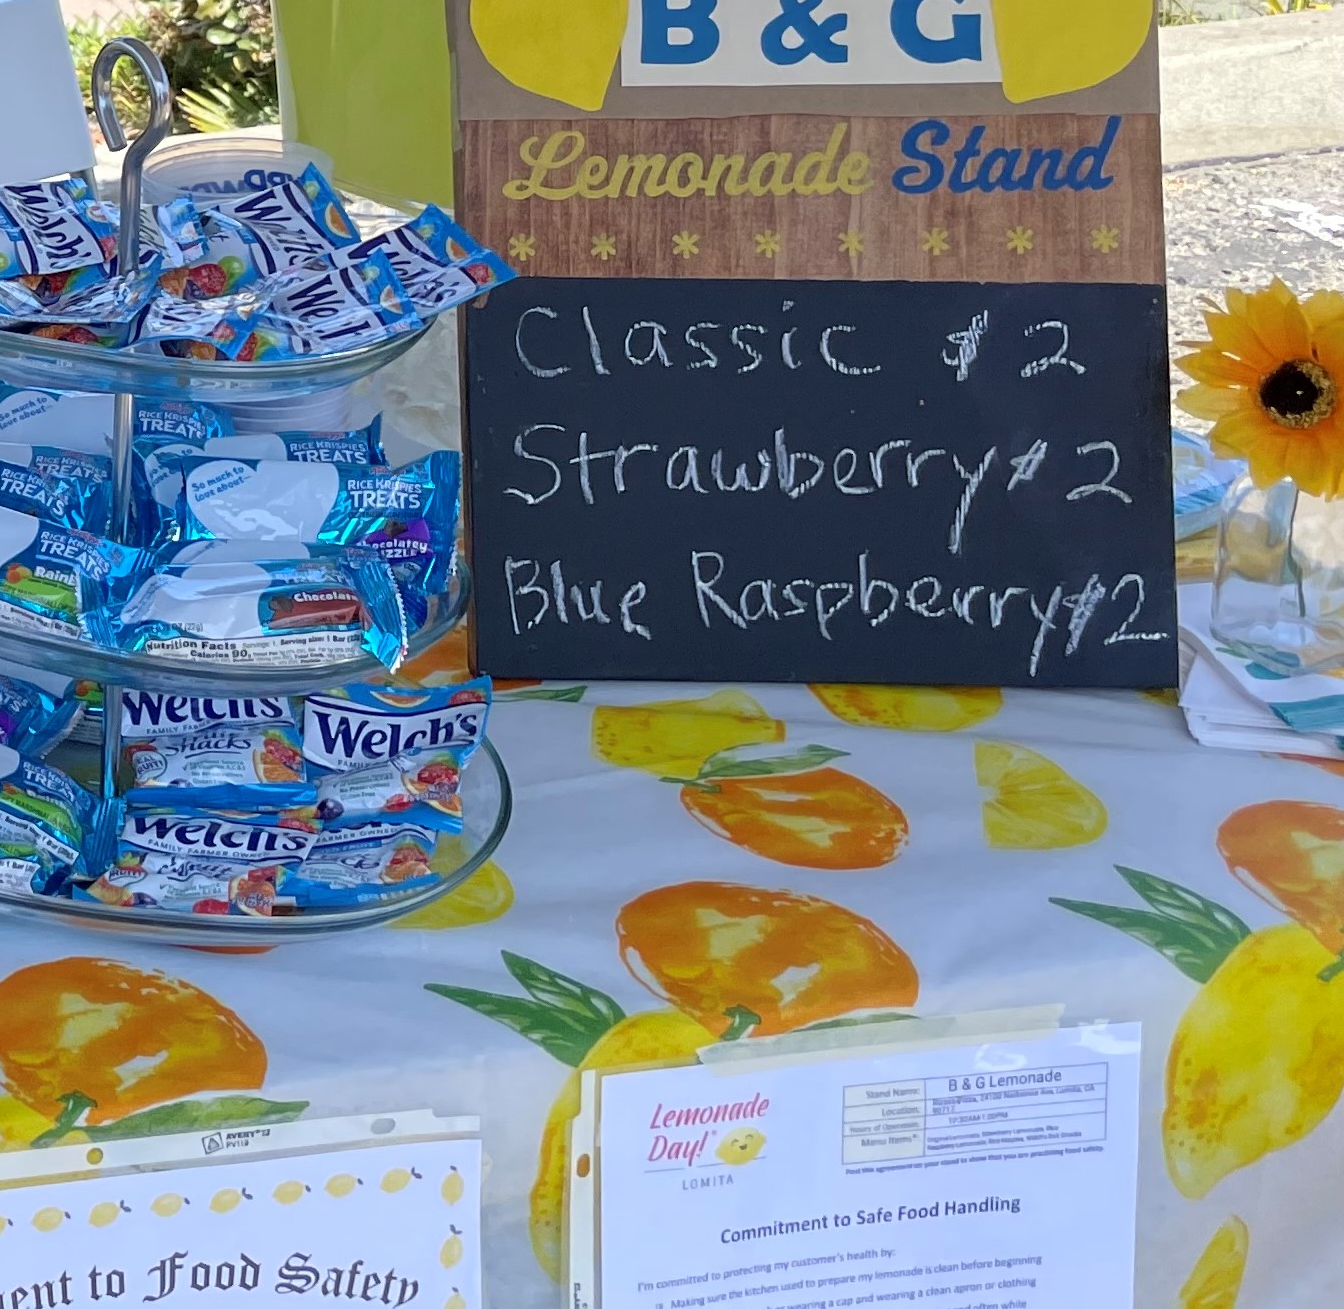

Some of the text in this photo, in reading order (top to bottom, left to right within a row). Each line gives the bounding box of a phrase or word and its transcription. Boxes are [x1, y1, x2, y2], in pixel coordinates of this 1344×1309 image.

[503, 116, 1122, 202] Lemonade Stand
[515, 300, 883, 379] Classic
[294, 450, 367, 465] TREATS
[348, 478, 422, 494] RICE KRISPIES
[350, 490, 421, 509] TREATS
[505, 424, 996, 553] Strawberry
[40, 540, 103, 582] TREATS
[505, 556, 651, 638] Blue
[692, 551, 1061, 678] Raspberry
[313, 710, 477, 760] Welch's
[135, 817, 309, 851] Welch's
[948, 1070, 1062, 1092] B & G Lemonade
[649, 1092, 769, 1129] Lemonade
[646, 1133, 708, 1167] Day!
[682, 1174, 734, 1191] LOMITA
[720, 1194, 1021, 1246] Commitment to Safe Food Handling
[88, 1265, 124, 1300] to
[143, 1251, 262, 1302] Food
[275, 1252, 419, 1307] Safety
